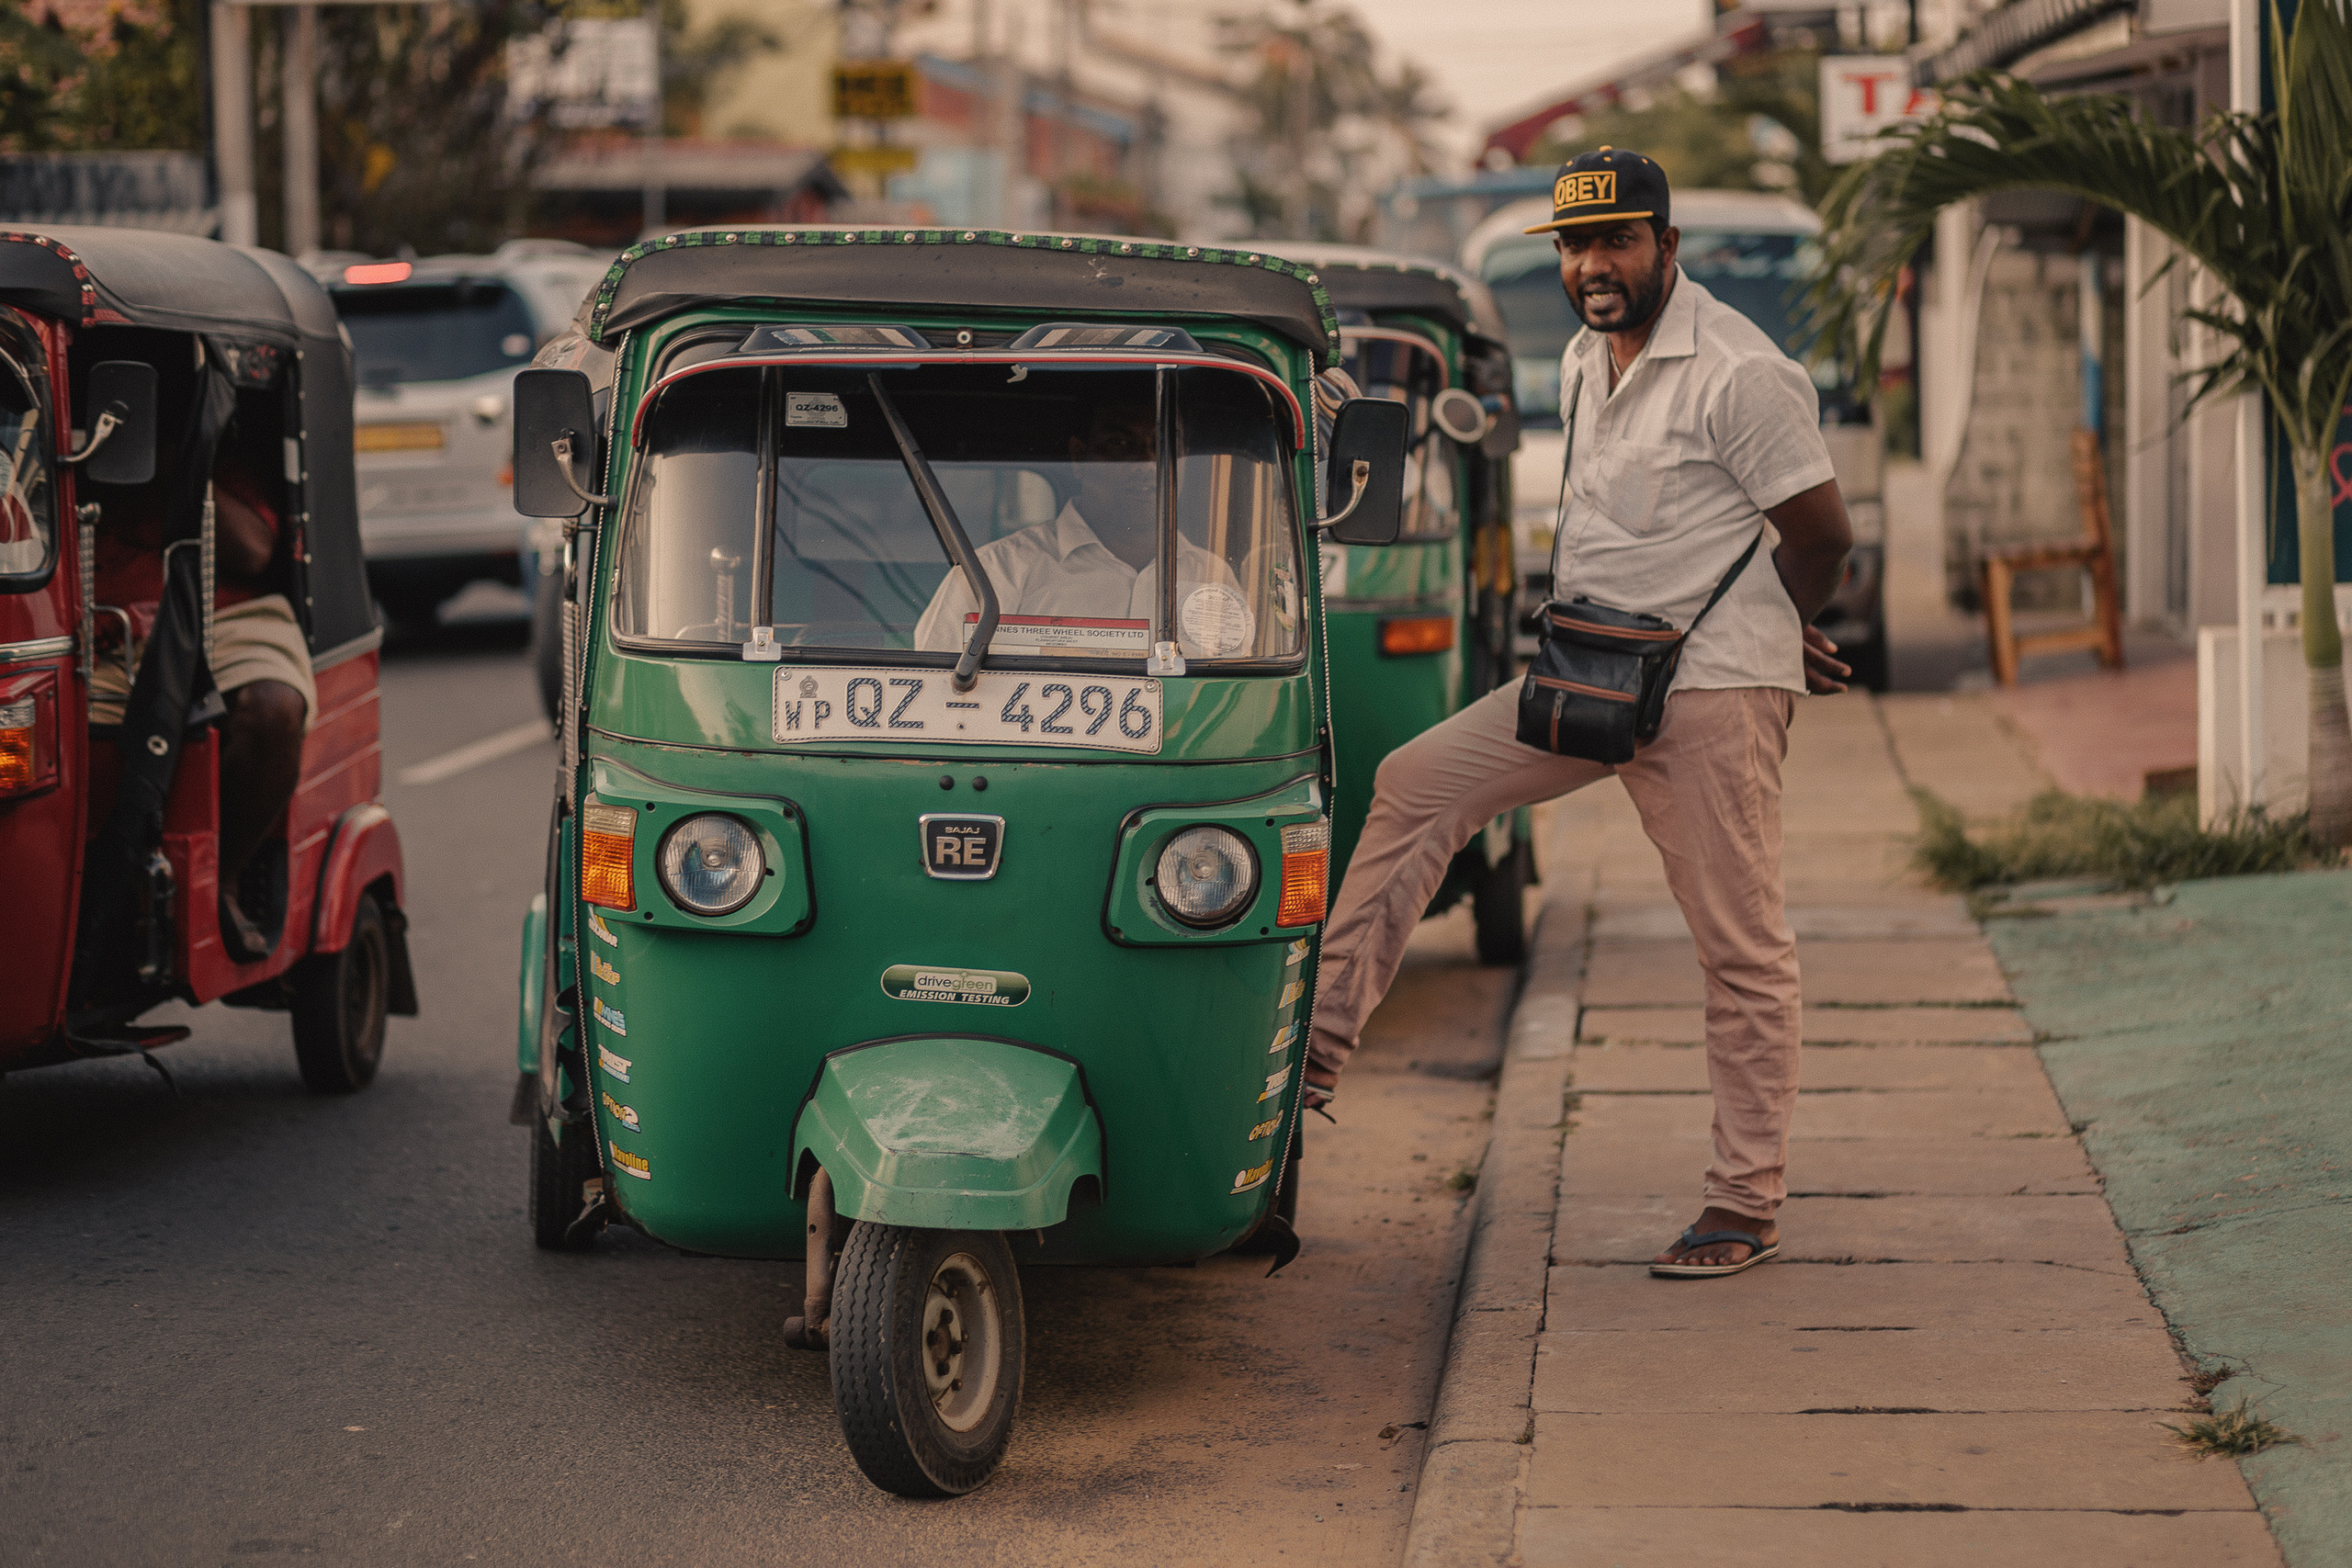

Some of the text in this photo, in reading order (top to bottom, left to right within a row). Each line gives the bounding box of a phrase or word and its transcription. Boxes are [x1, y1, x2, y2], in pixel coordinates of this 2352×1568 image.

[1555, 175, 1611, 206] OBEY
[796, 404, 838, 412] QZ-4296
[1020, 626, 1051, 635] THREE
[1053, 628, 1084, 637] WHEEL
[846, 678, 923, 729] QZ
[1001, 682, 1152, 739] 4296
[944, 826, 980, 834] BAJAJ
[936, 836, 987, 866] RE
[917, 976, 993, 991] drivegreen
[899, 989, 1011, 1005] EMISSION TESTING
